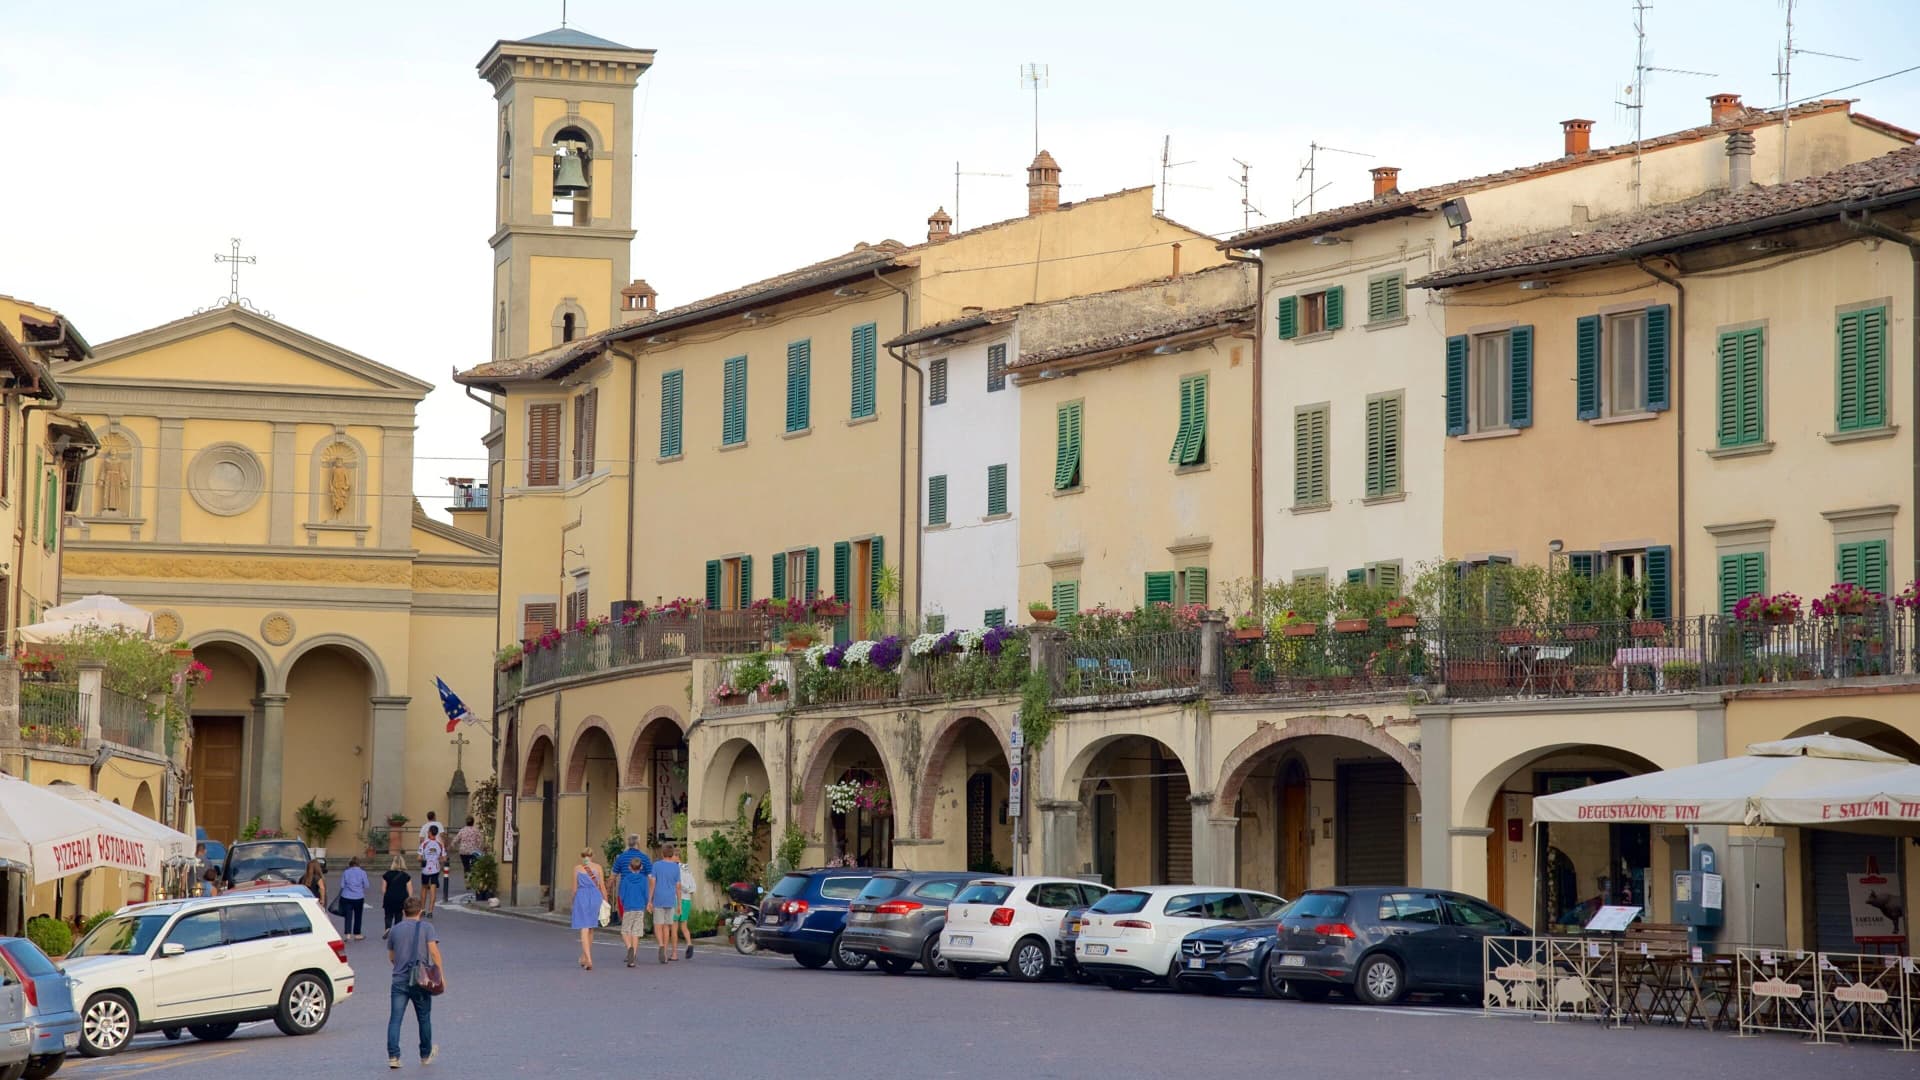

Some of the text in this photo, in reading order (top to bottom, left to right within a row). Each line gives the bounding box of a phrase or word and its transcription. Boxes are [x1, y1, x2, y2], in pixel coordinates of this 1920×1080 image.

[659, 751, 670, 831] ENOTECA
[1578, 804, 1700, 819] DEGUSTAZIONE VINI
[1822, 804, 1832, 819] E
[1840, 801, 1889, 818] SALUMI
[53, 838, 92, 872] PIZZERIA
[97, 834, 146, 868] RISTORANTE
[1703, 854, 1712, 869] P
